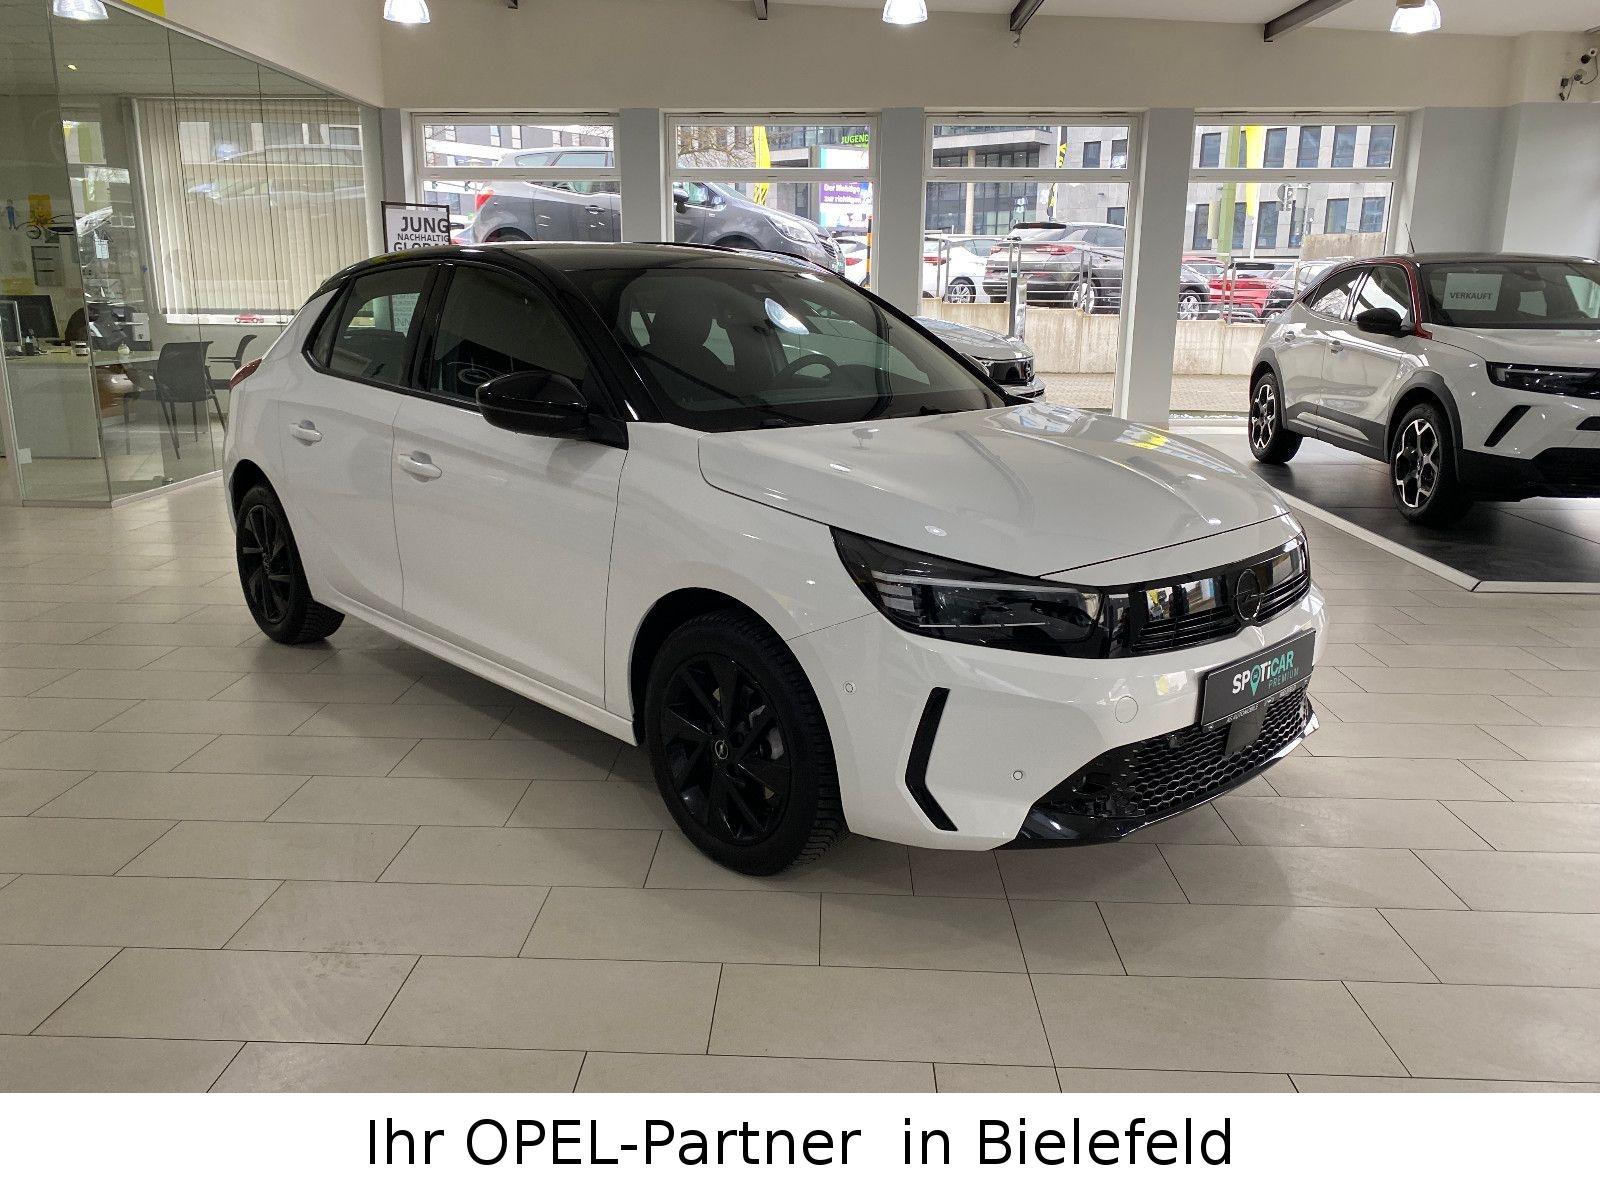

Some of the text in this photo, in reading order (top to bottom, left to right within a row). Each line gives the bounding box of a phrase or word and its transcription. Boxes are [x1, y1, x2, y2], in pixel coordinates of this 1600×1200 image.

[400, 216, 450, 233] JUNG
[397, 233, 450, 242] NACHHALTIG
[1450, 292, 1492, 300] VERKAUFT
[1268, 667, 1300, 690] PREMIUM
